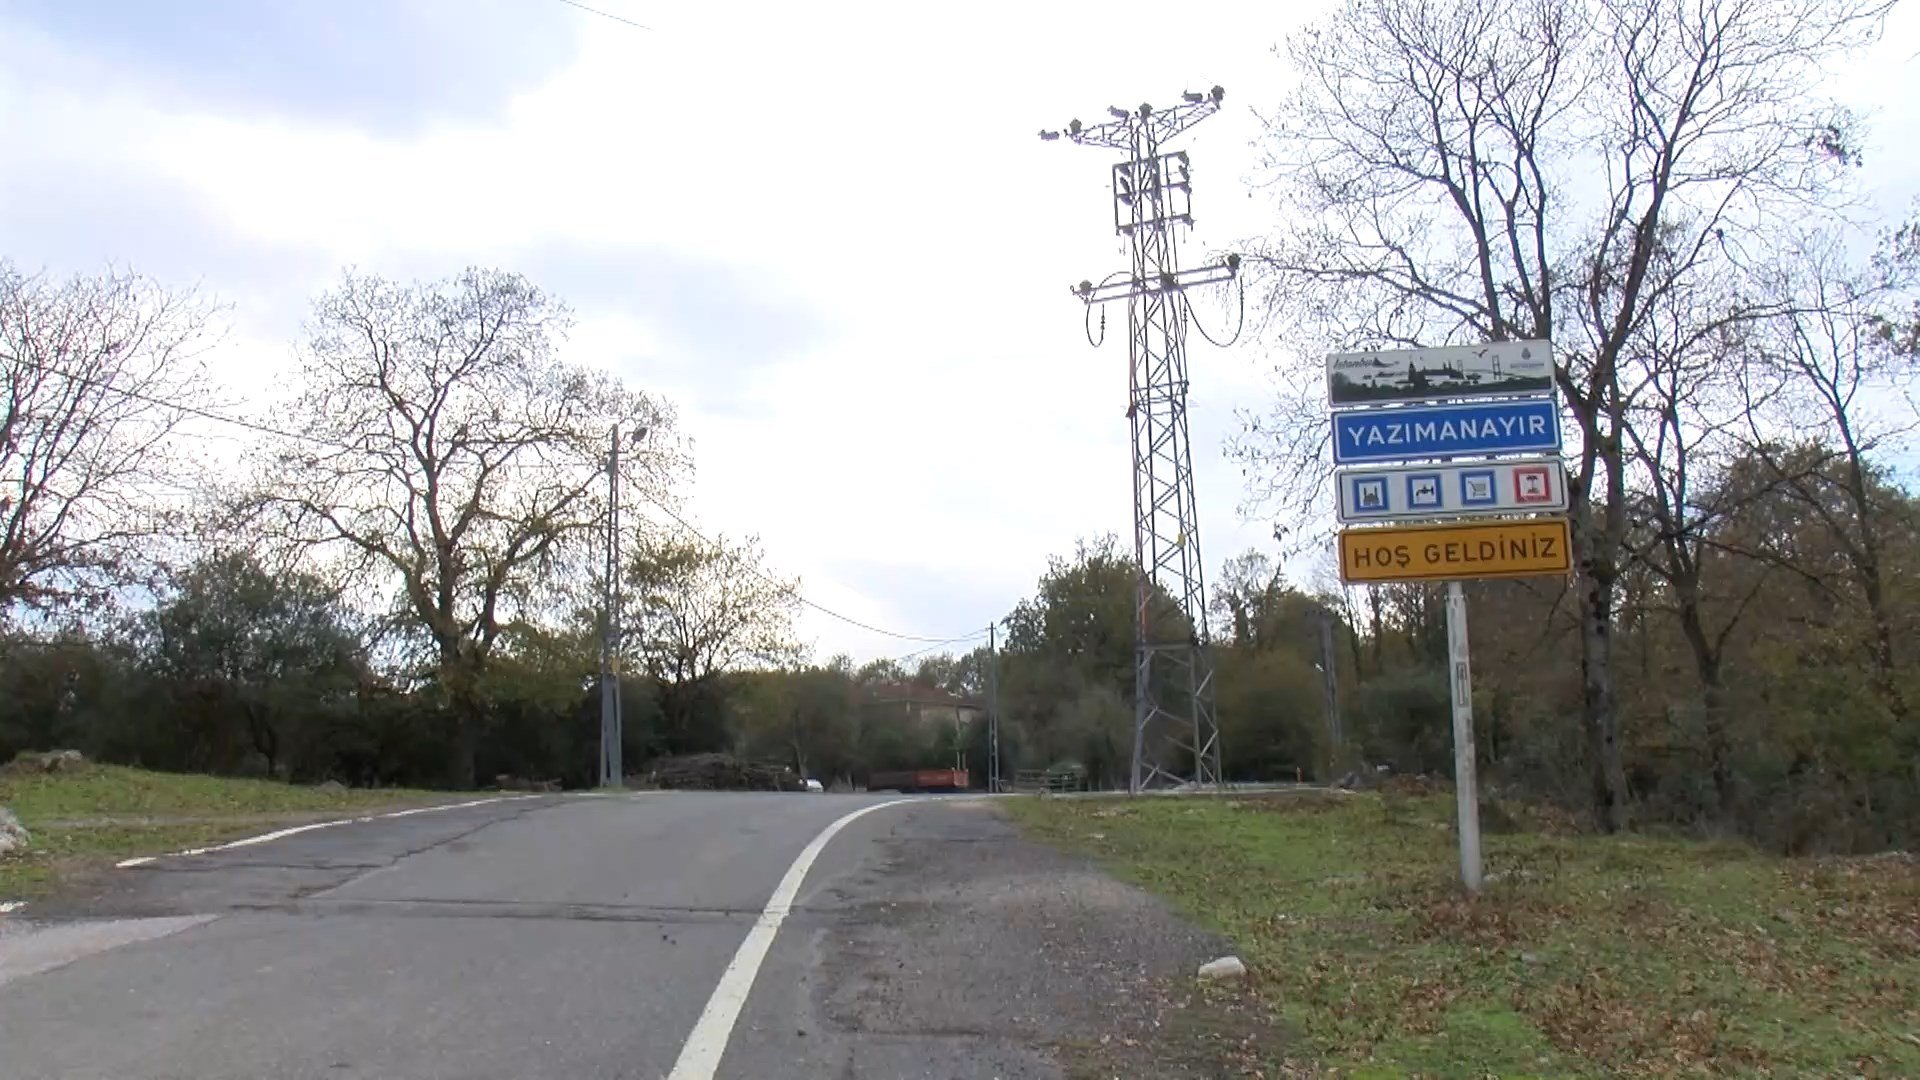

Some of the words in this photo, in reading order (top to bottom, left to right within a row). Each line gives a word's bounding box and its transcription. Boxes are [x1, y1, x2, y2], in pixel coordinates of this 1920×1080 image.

[1347, 415, 1546, 446] YAZIMANAYIR
[1353, 544, 1411, 568] HOŞ
[1424, 532, 1557, 565] GELDİNİZ
